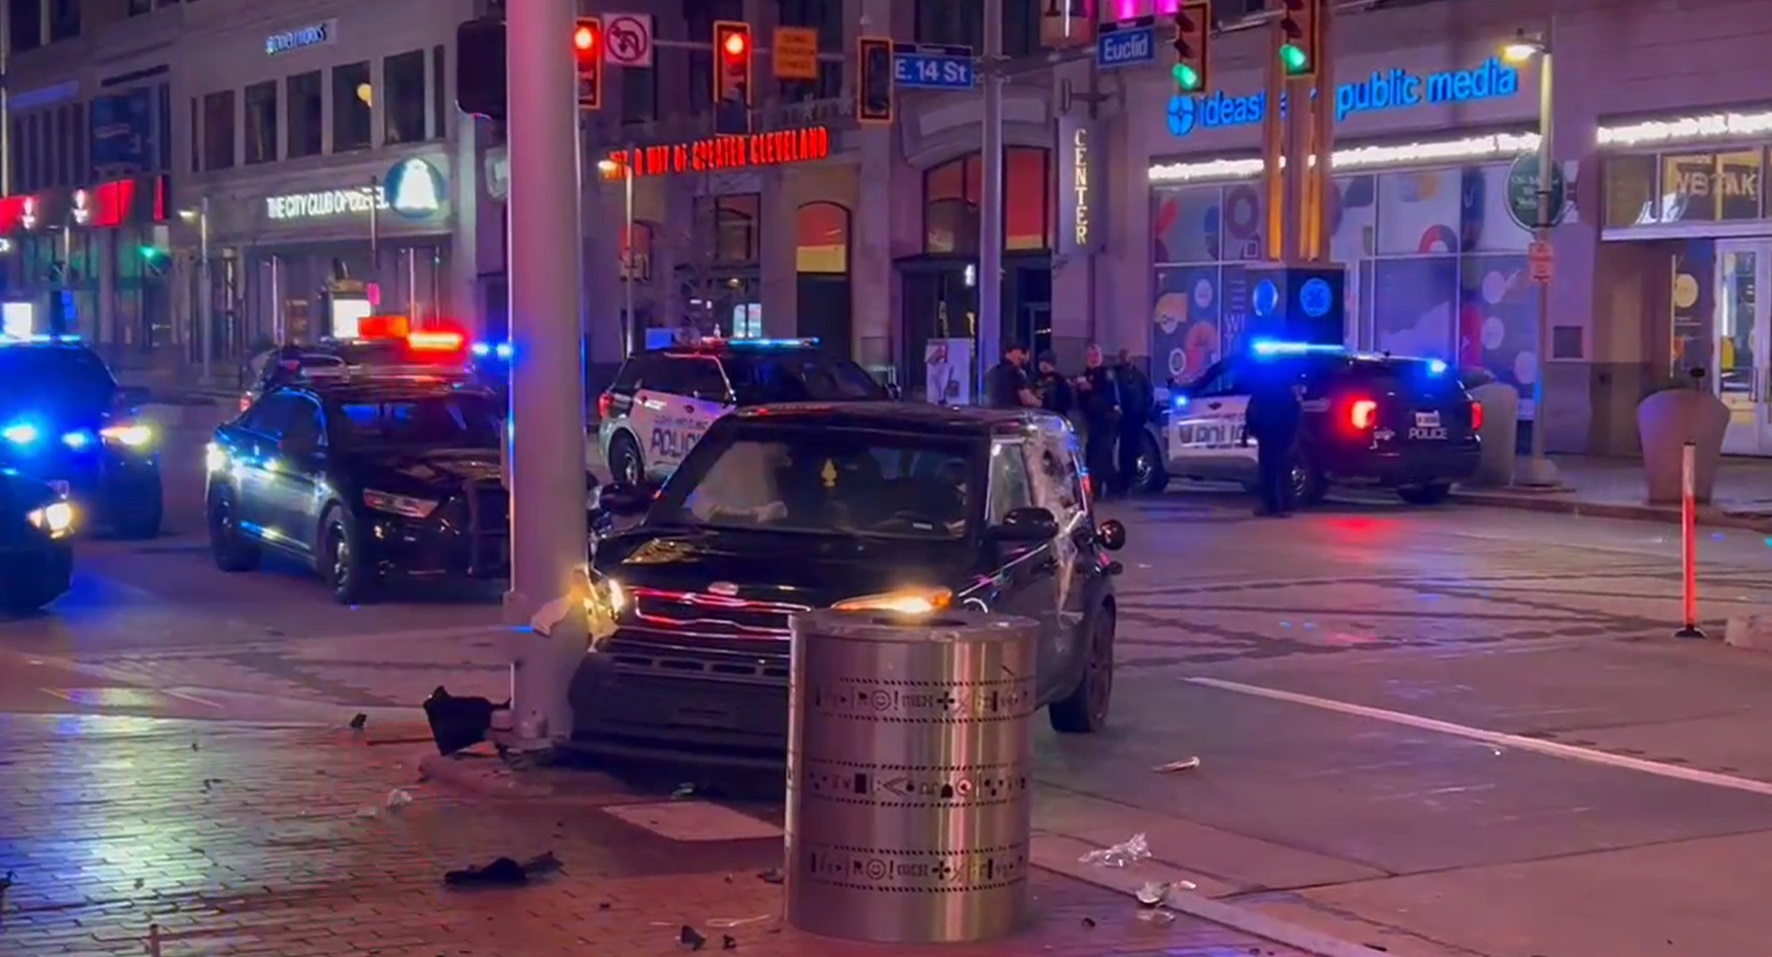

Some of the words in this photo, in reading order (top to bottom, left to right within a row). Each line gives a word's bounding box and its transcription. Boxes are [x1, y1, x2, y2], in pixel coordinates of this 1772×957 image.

[1104, 33, 1149, 60] Euclid
[895, 60, 912, 79] E.
[916, 61, 939, 81] 14
[944, 61, 967, 82] St
[1336, 69, 1422, 122] public
[1427, 57, 1518, 102] media
[692, 136, 746, 170] GREATER
[751, 126, 828, 163] CLEVELAND
[1074, 128, 1088, 246] CENTER
[266, 197, 285, 219] THE
[285, 195, 308, 218] CITY
[308, 190, 333, 216] CLUB
[650, 427, 701, 458] POLIC
[1408, 427, 1448, 440] POLICE
